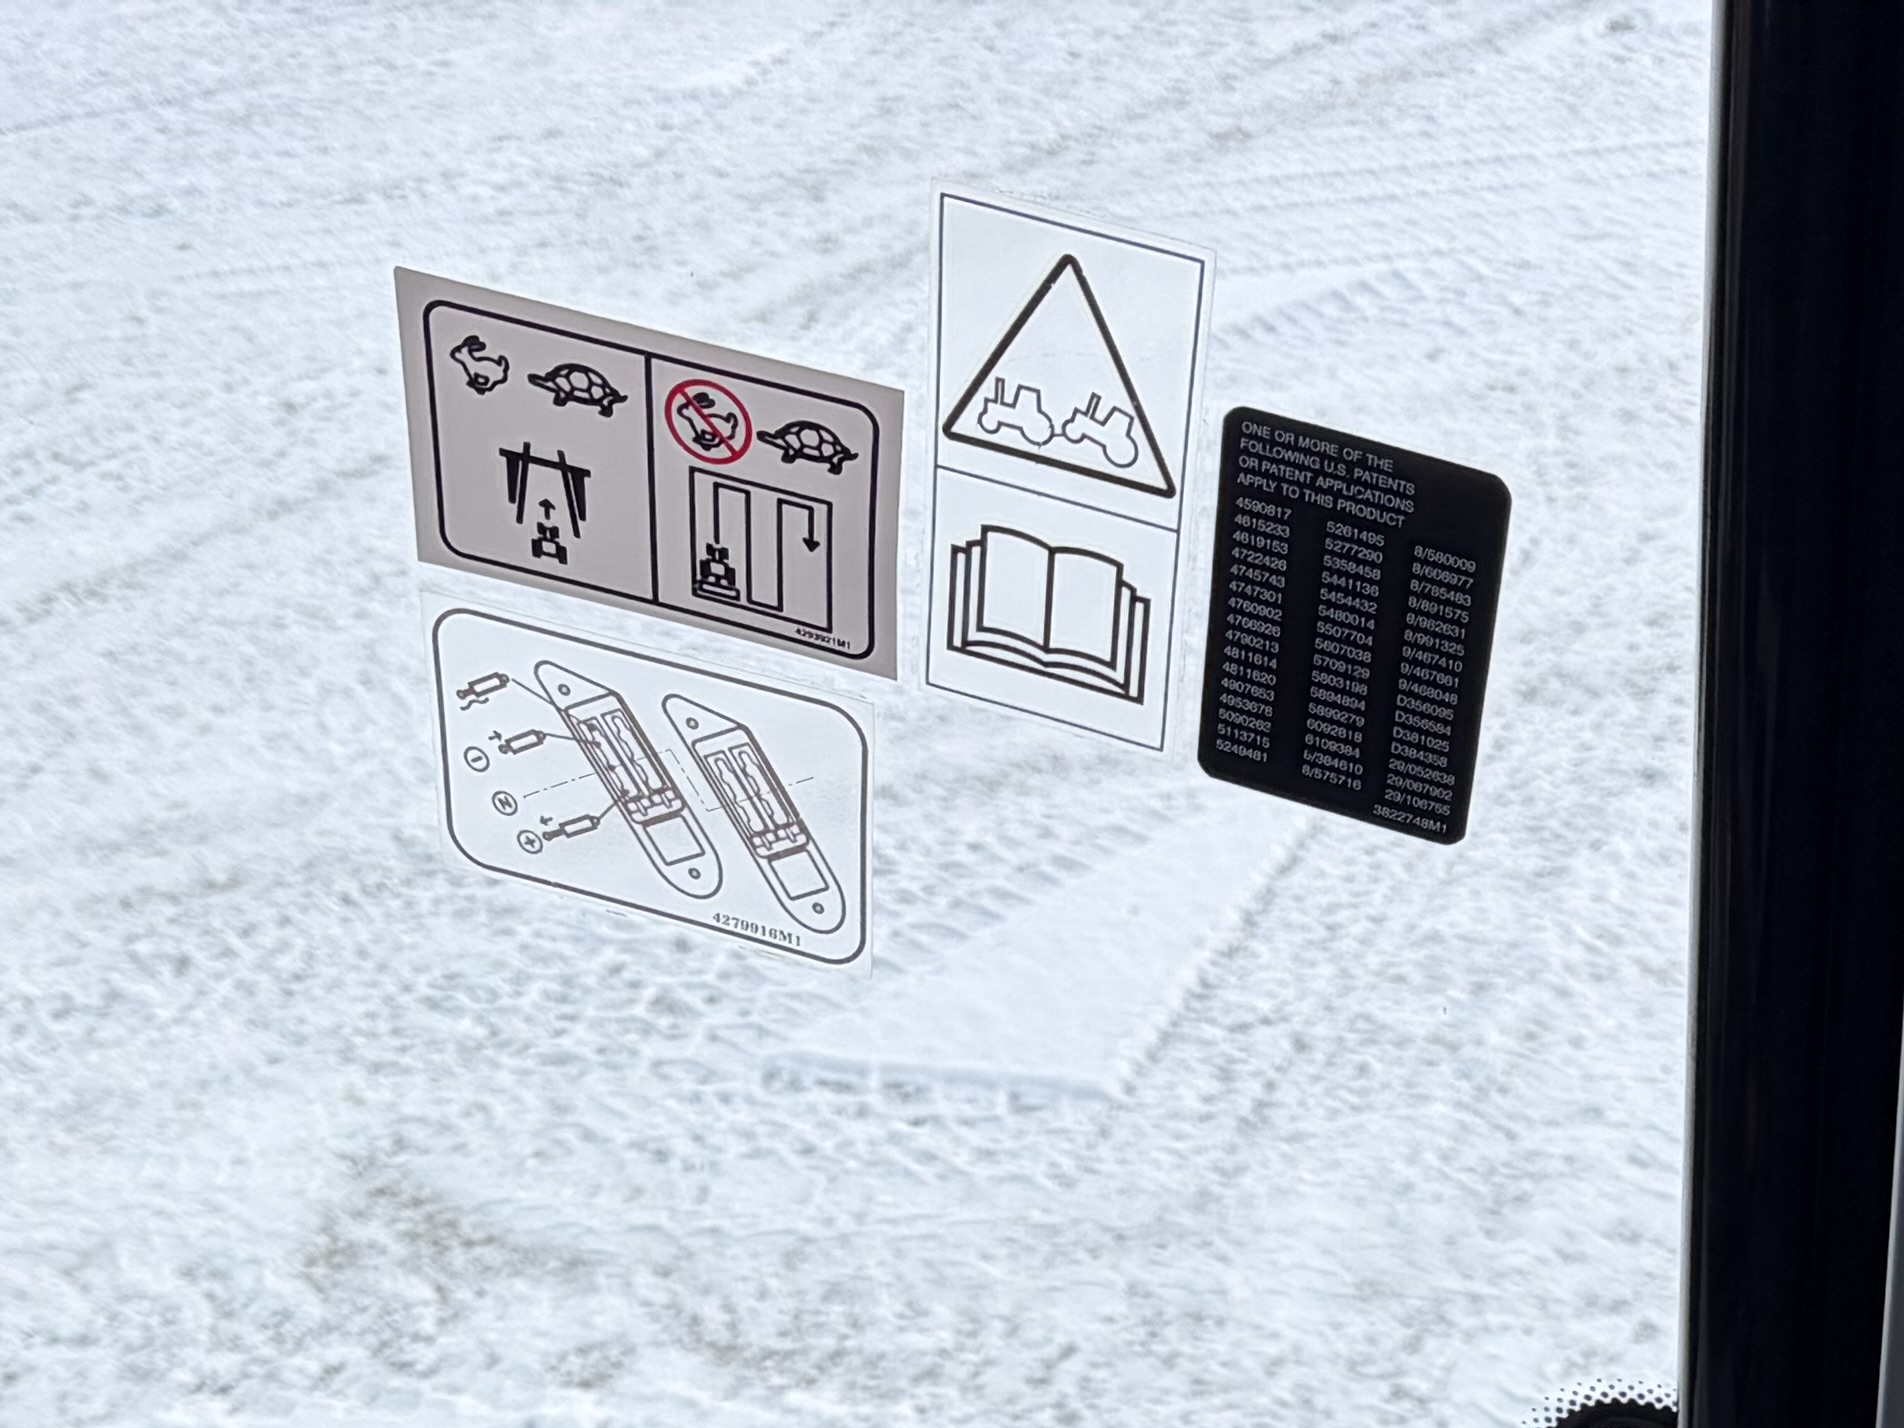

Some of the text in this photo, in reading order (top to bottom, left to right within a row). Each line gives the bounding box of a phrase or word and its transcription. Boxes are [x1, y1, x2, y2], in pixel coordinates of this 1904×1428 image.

[1239, 436, 1415, 496] FOLLOWING U.S. PATENTS
[1241, 420, 1394, 473] ONE OR MORE OF THE
[1236, 471, 1406, 528] APPLY TO THIS PRODUCT
[1238, 454, 1415, 513] OR PATENT APPLICATIONS
[713, 912, 801, 947] 4279916M1
